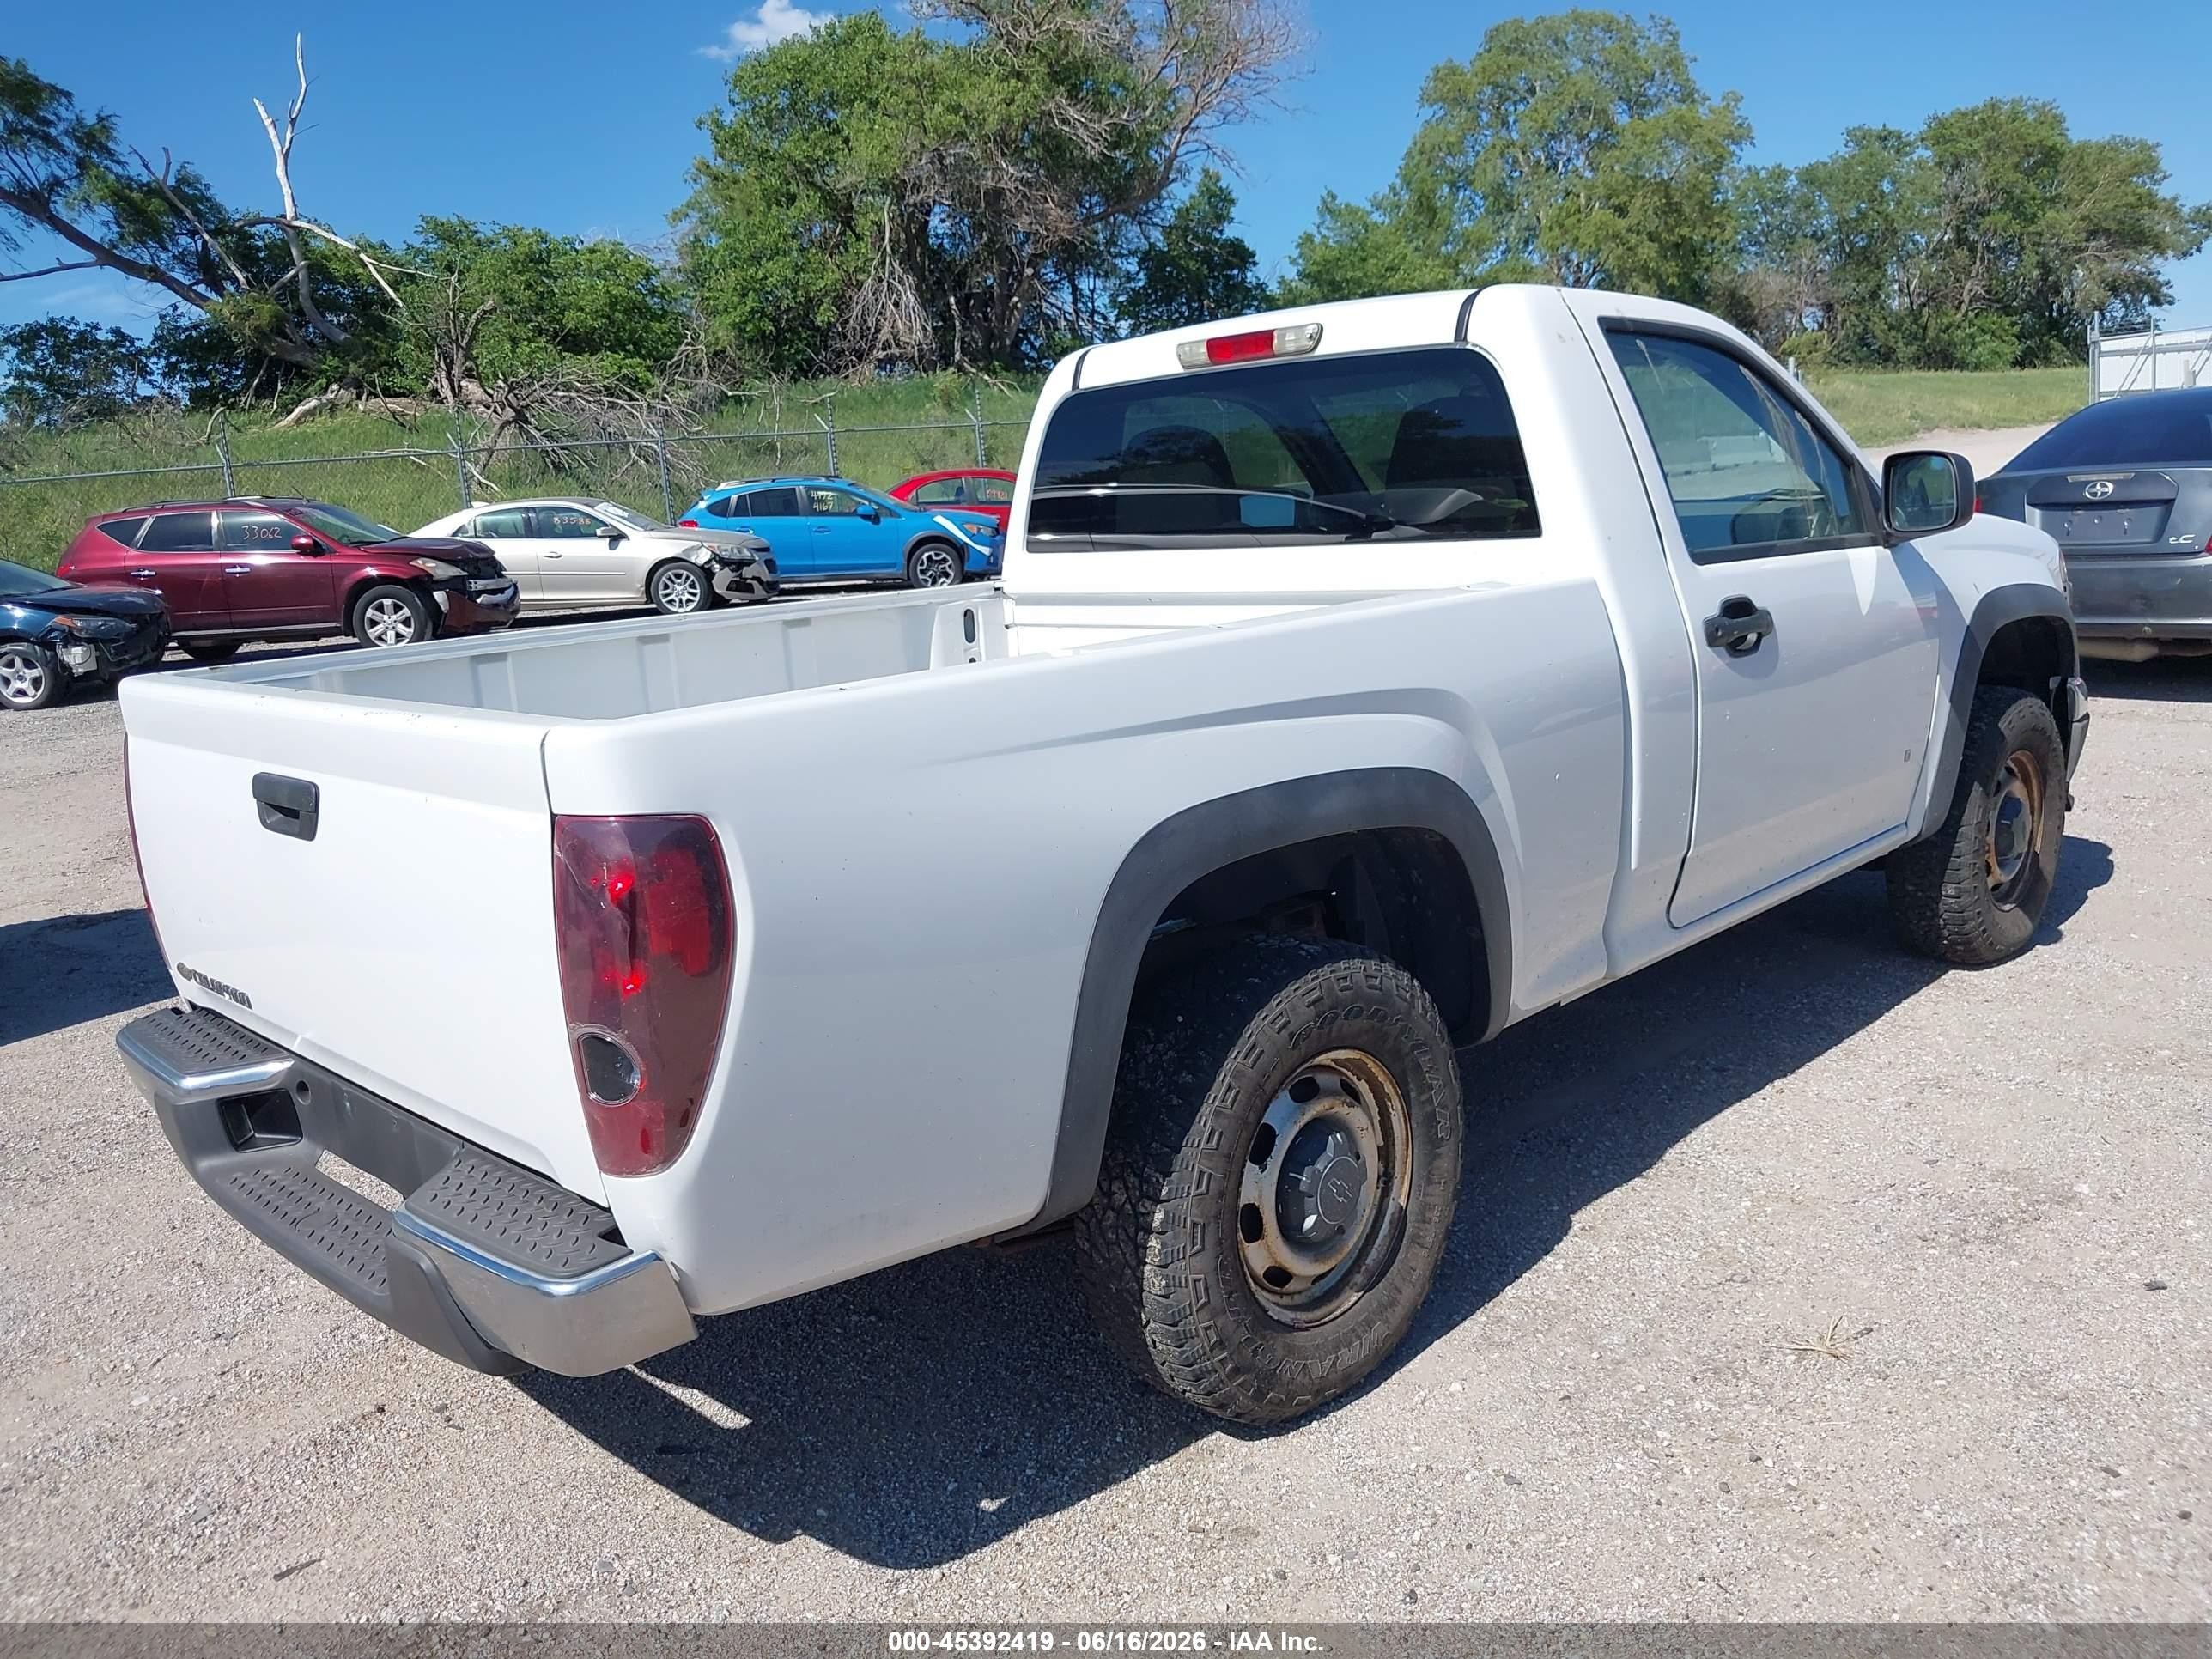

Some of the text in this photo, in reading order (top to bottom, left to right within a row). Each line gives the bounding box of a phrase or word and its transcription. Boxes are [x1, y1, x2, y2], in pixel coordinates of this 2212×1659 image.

[812, 501, 834, 512] 4167
[241, 526, 283, 540] 33062
[1288, 1003, 1451, 1140] GOODYEAR
